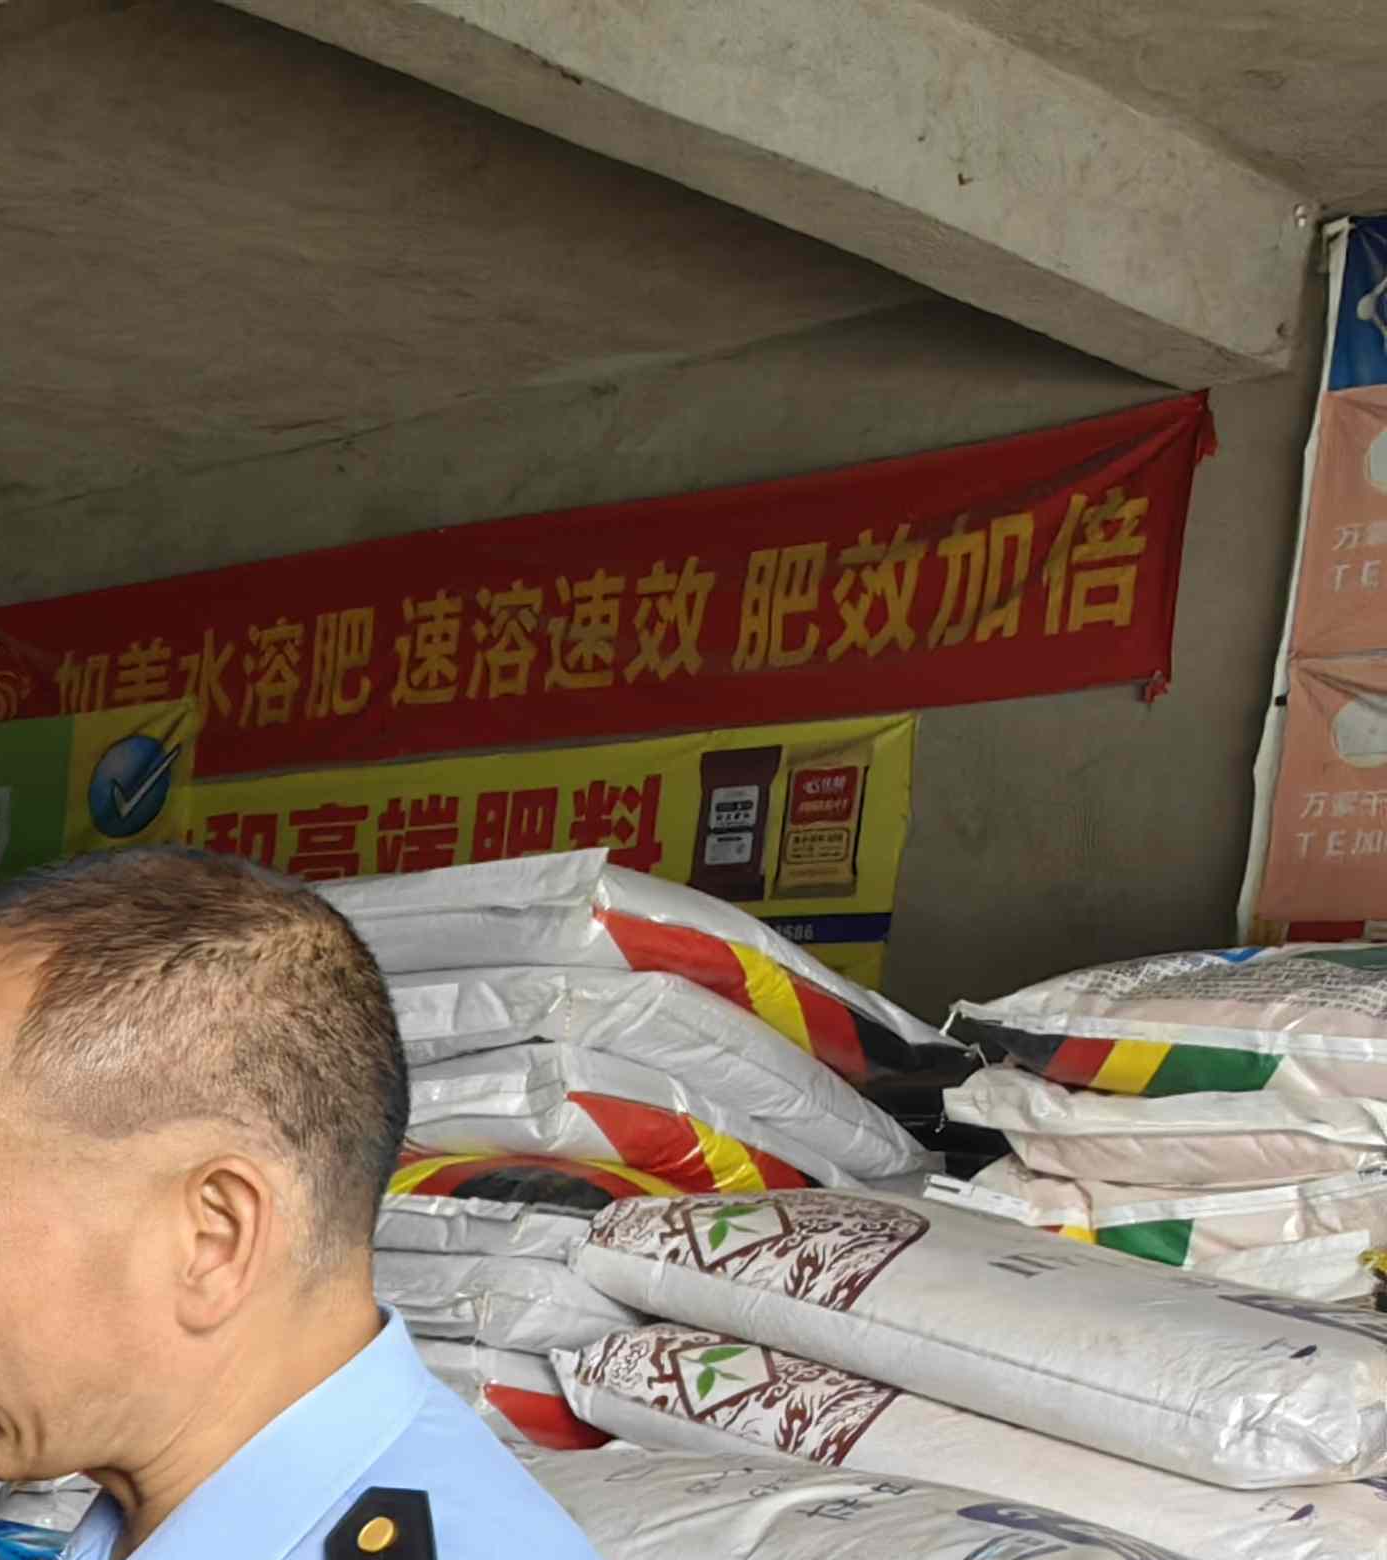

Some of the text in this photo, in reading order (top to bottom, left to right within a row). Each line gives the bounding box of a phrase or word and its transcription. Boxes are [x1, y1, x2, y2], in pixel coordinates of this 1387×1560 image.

[389, 555, 715, 709] 速溶速效
[730, 486, 1152, 672] 肥效加倍
